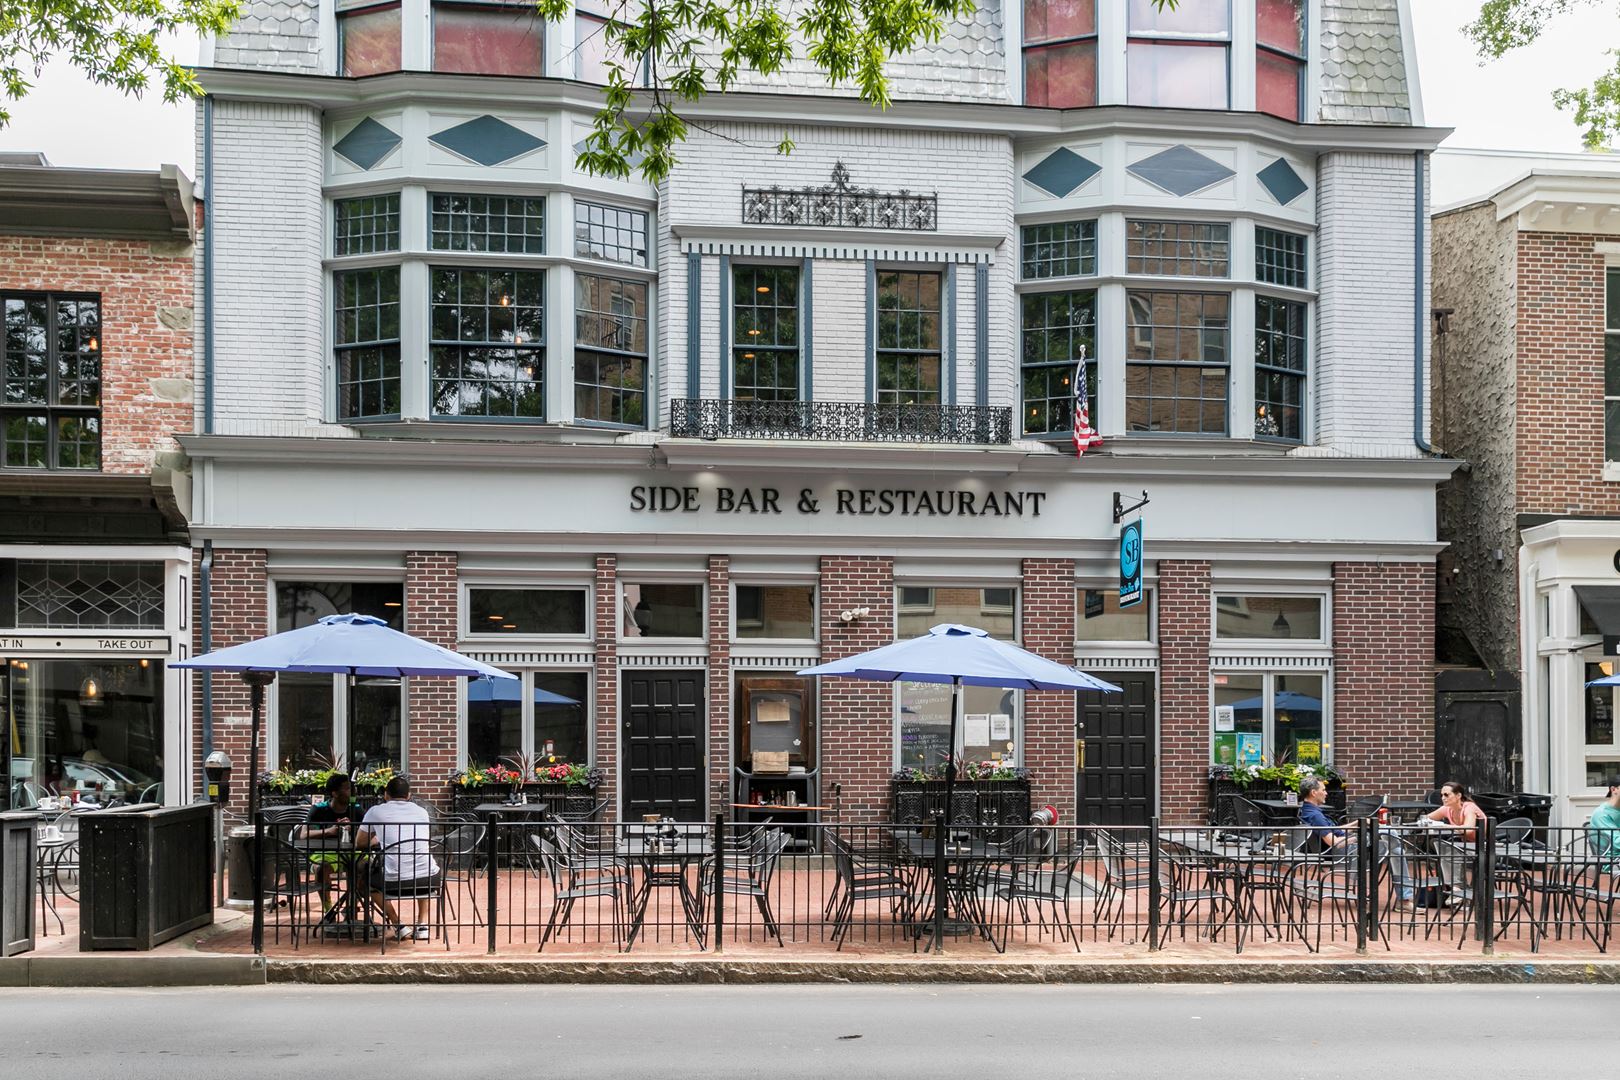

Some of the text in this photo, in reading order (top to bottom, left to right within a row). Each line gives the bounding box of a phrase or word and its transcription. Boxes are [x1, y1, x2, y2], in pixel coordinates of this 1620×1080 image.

[630, 486, 1046, 516] SIDE BAR & RESTAURANT
[1125, 538, 1139, 565] SB
[12, 640, 23, 648] IN
[98, 640, 153, 649] TAKE OUT
